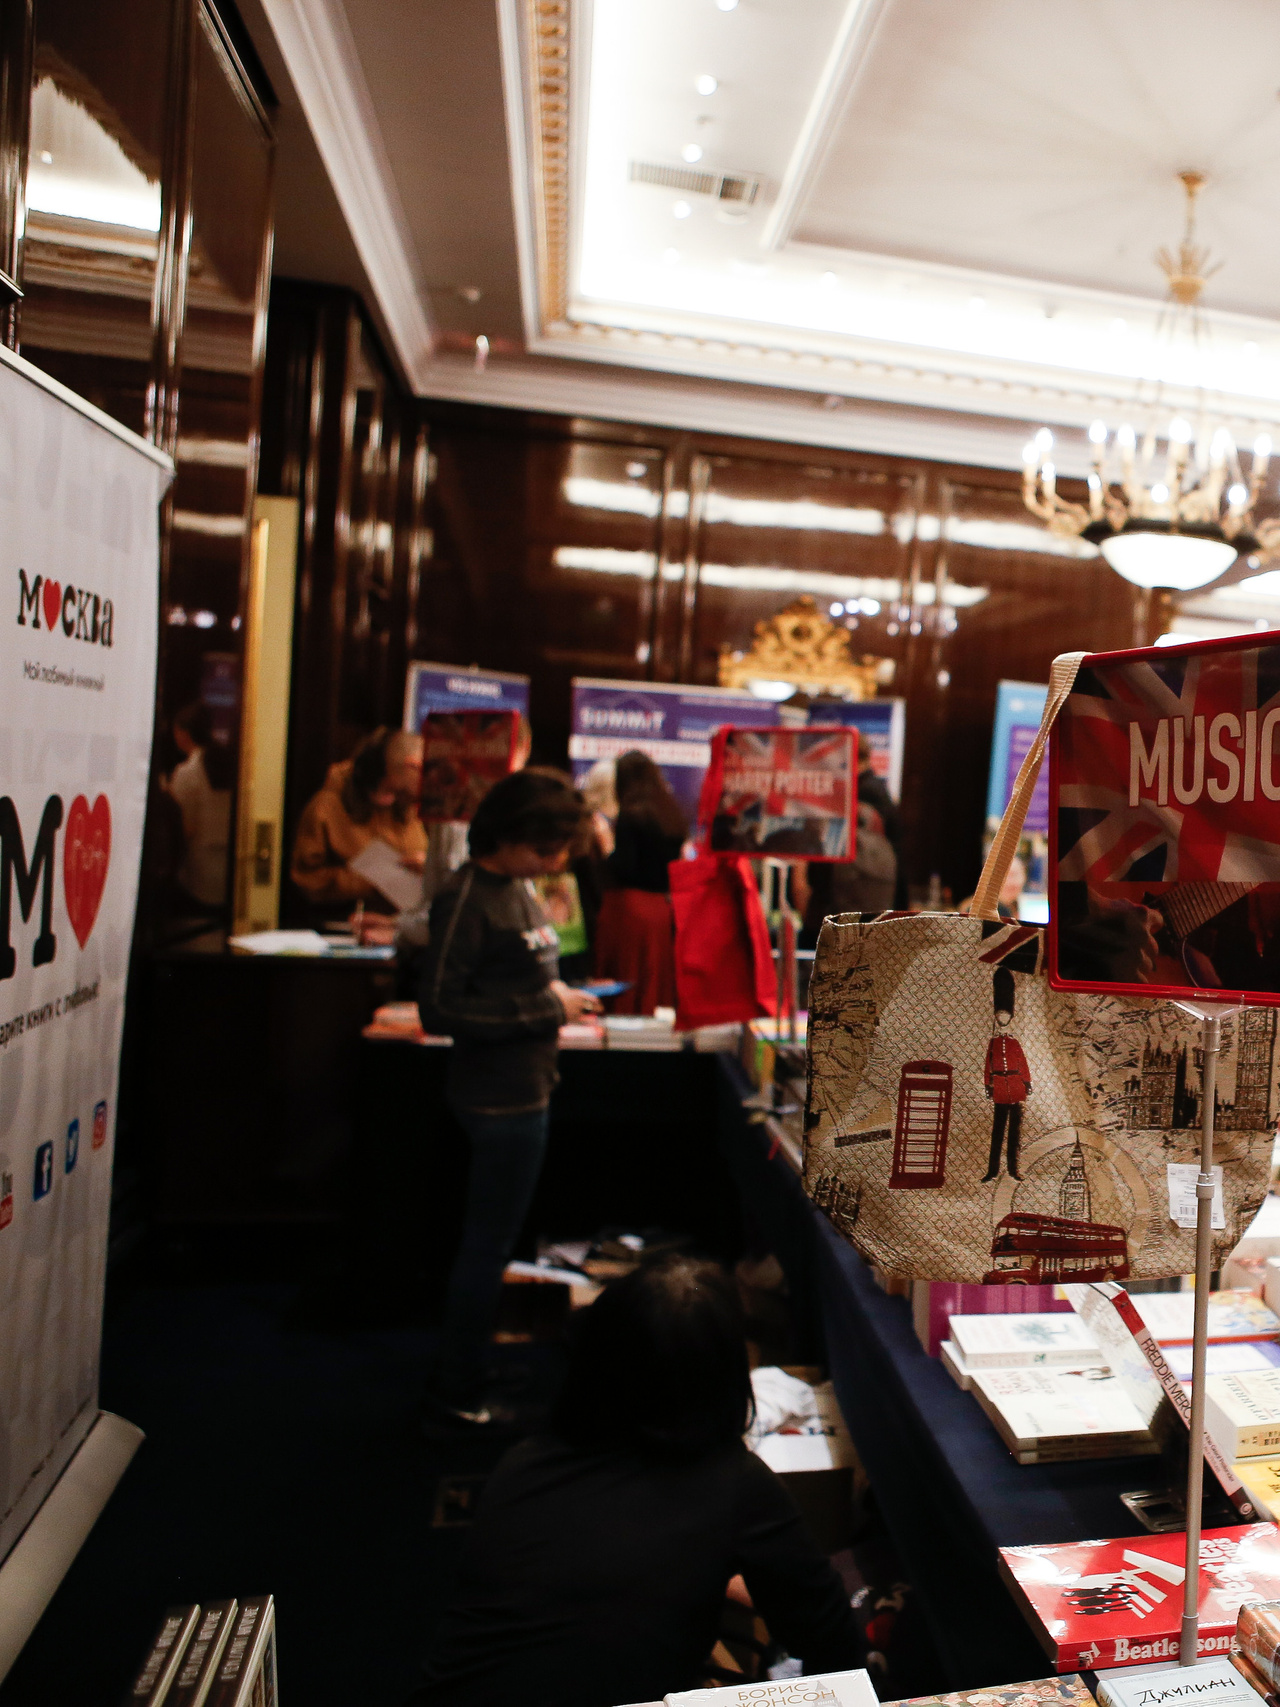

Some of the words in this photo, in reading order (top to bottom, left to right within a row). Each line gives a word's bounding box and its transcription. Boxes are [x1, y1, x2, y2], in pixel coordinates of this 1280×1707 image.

[775, 771, 834, 796] POTTER
[1141, 1337, 1175, 1391] FREDDIE
[1168, 1383, 1192, 1423] MERC
[1113, 1638, 1181, 1662] Beatle
[1196, 1634, 1241, 1654] song
[728, 1688, 836, 1707] ЖОНСОН
[738, 1682, 810, 1701] БОРИС
[1133, 1677, 1236, 1707] ДЖУЛИАН
